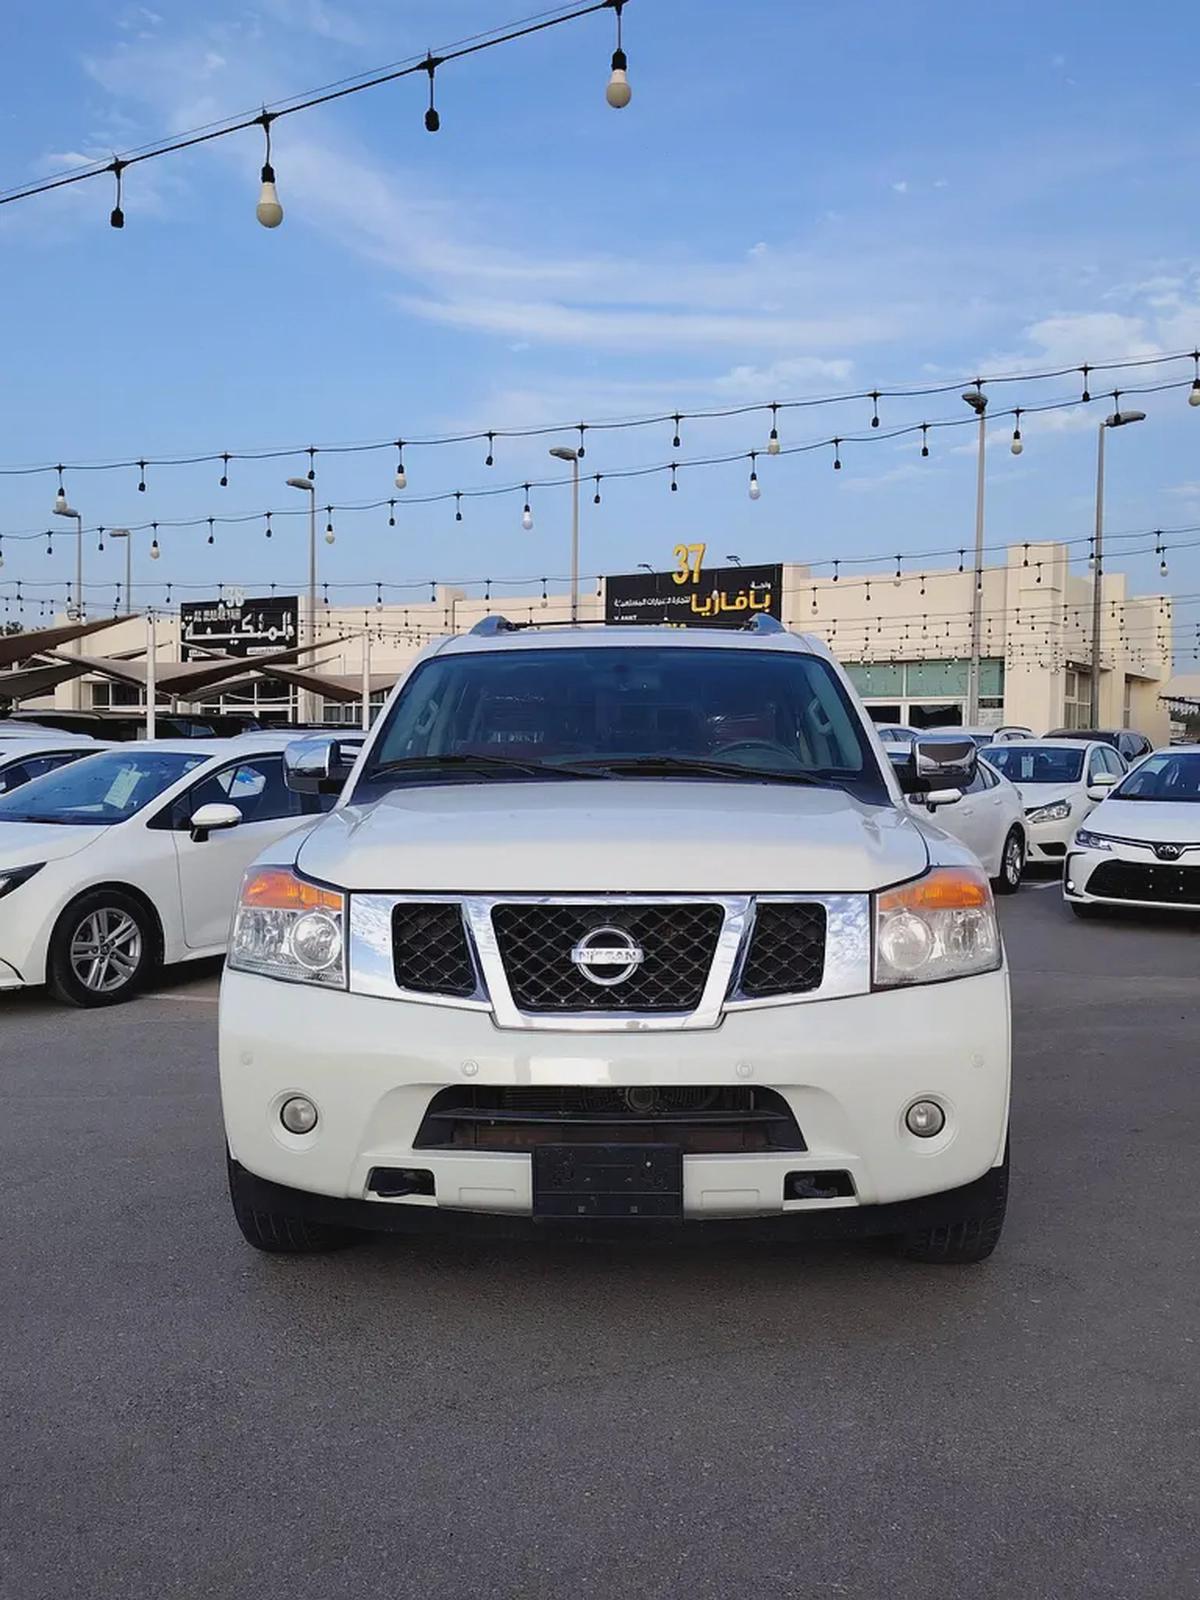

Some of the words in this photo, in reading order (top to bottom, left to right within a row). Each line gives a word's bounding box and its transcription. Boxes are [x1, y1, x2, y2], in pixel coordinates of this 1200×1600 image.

[672, 543, 706, 584] 37
[691, 590, 771, 616] بافاريا
[579, 950, 636, 961] NISSAN
